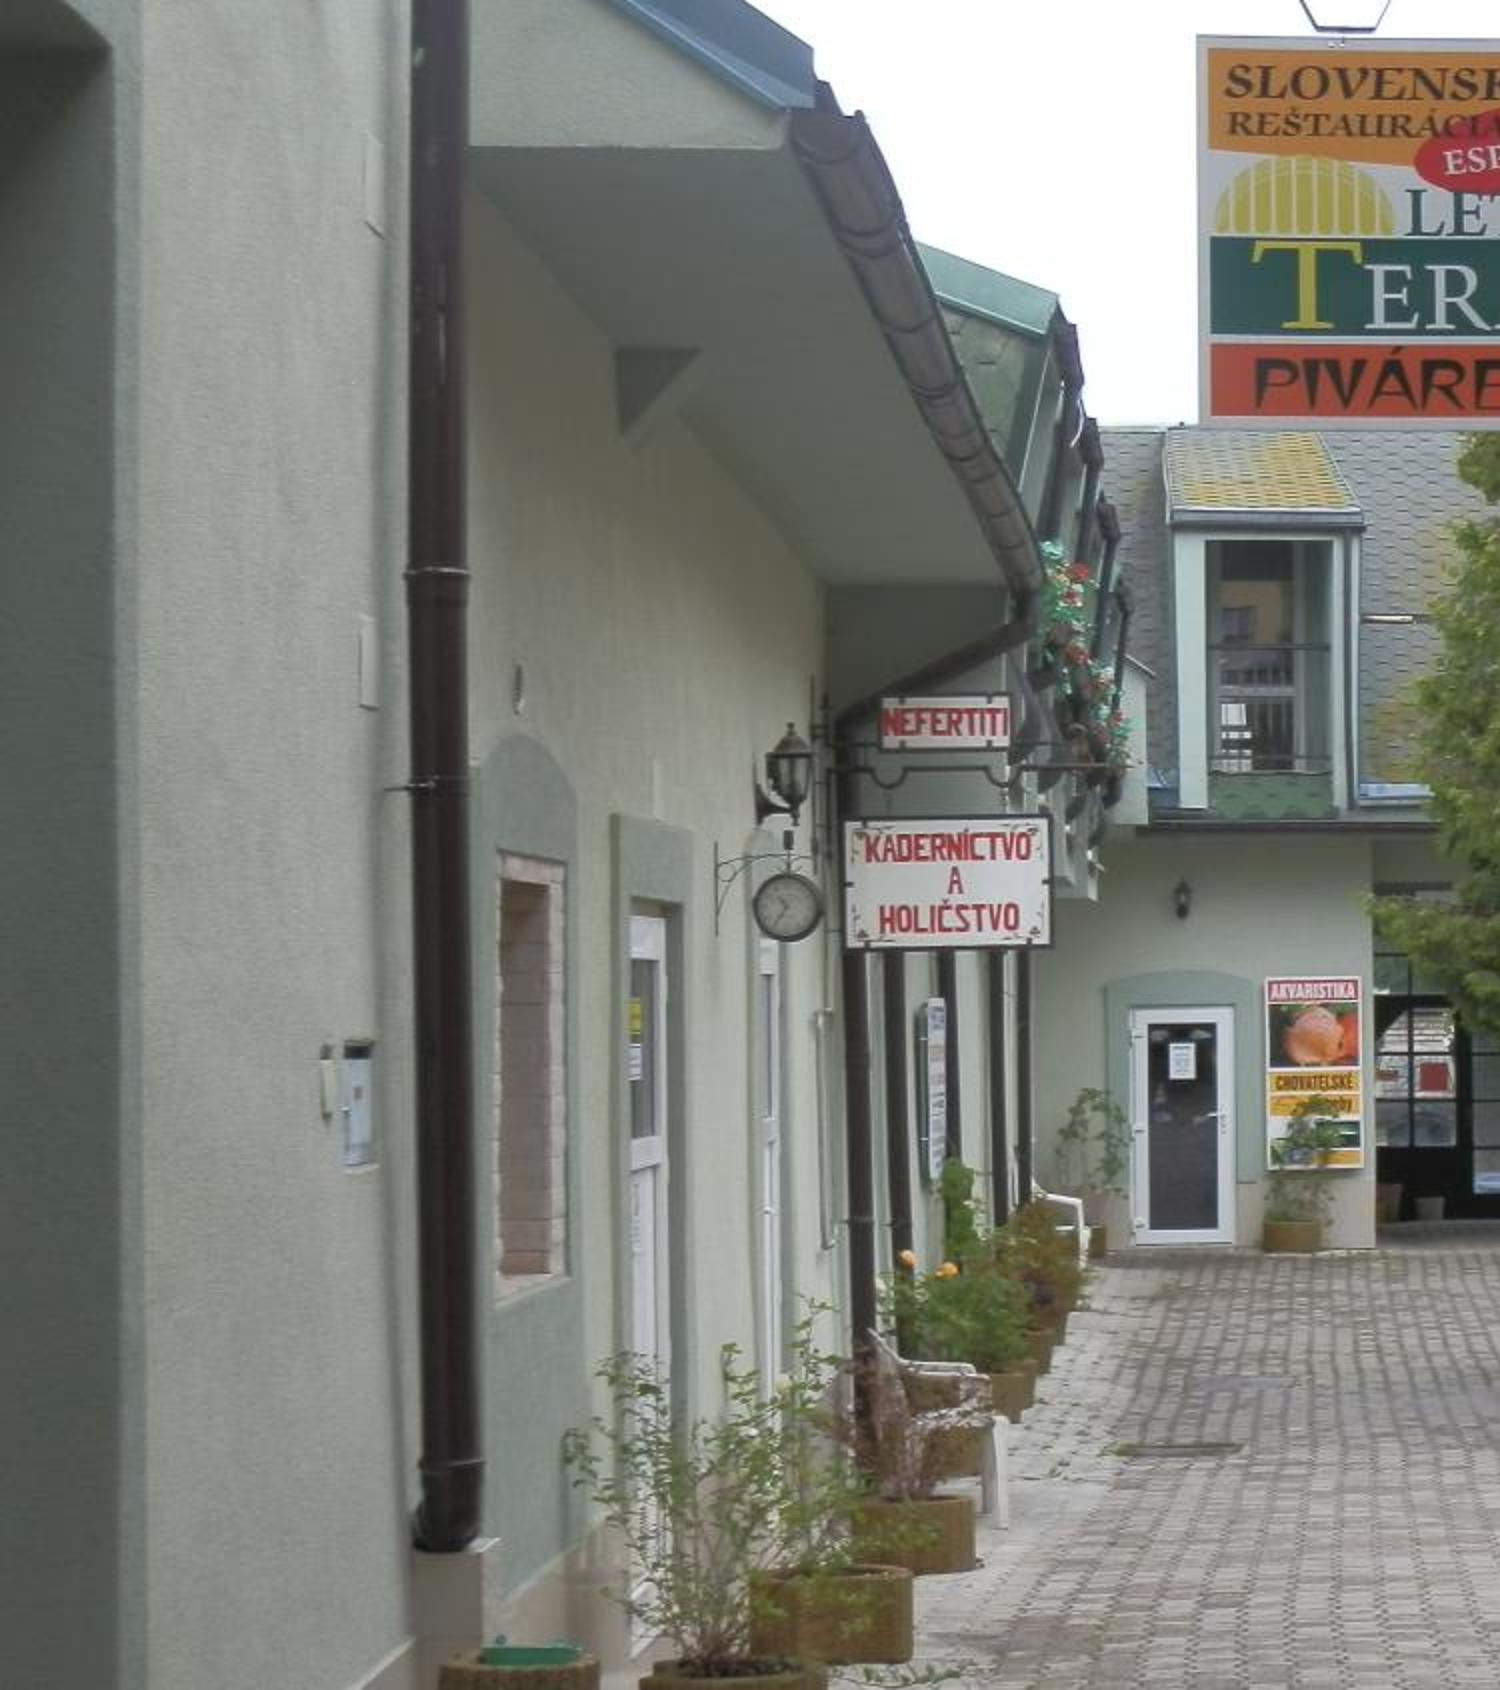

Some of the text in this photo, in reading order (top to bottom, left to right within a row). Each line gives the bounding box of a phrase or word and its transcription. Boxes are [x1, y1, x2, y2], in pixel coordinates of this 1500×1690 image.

[881, 707, 1010, 738] NEFERTITI
[865, 828, 1032, 863] KADERNÍCTVO
[947, 866, 964, 895] A
[879, 898, 1020, 935] HOLIČSTVO
[1270, 982, 1355, 1000] AKVARISTIKA
